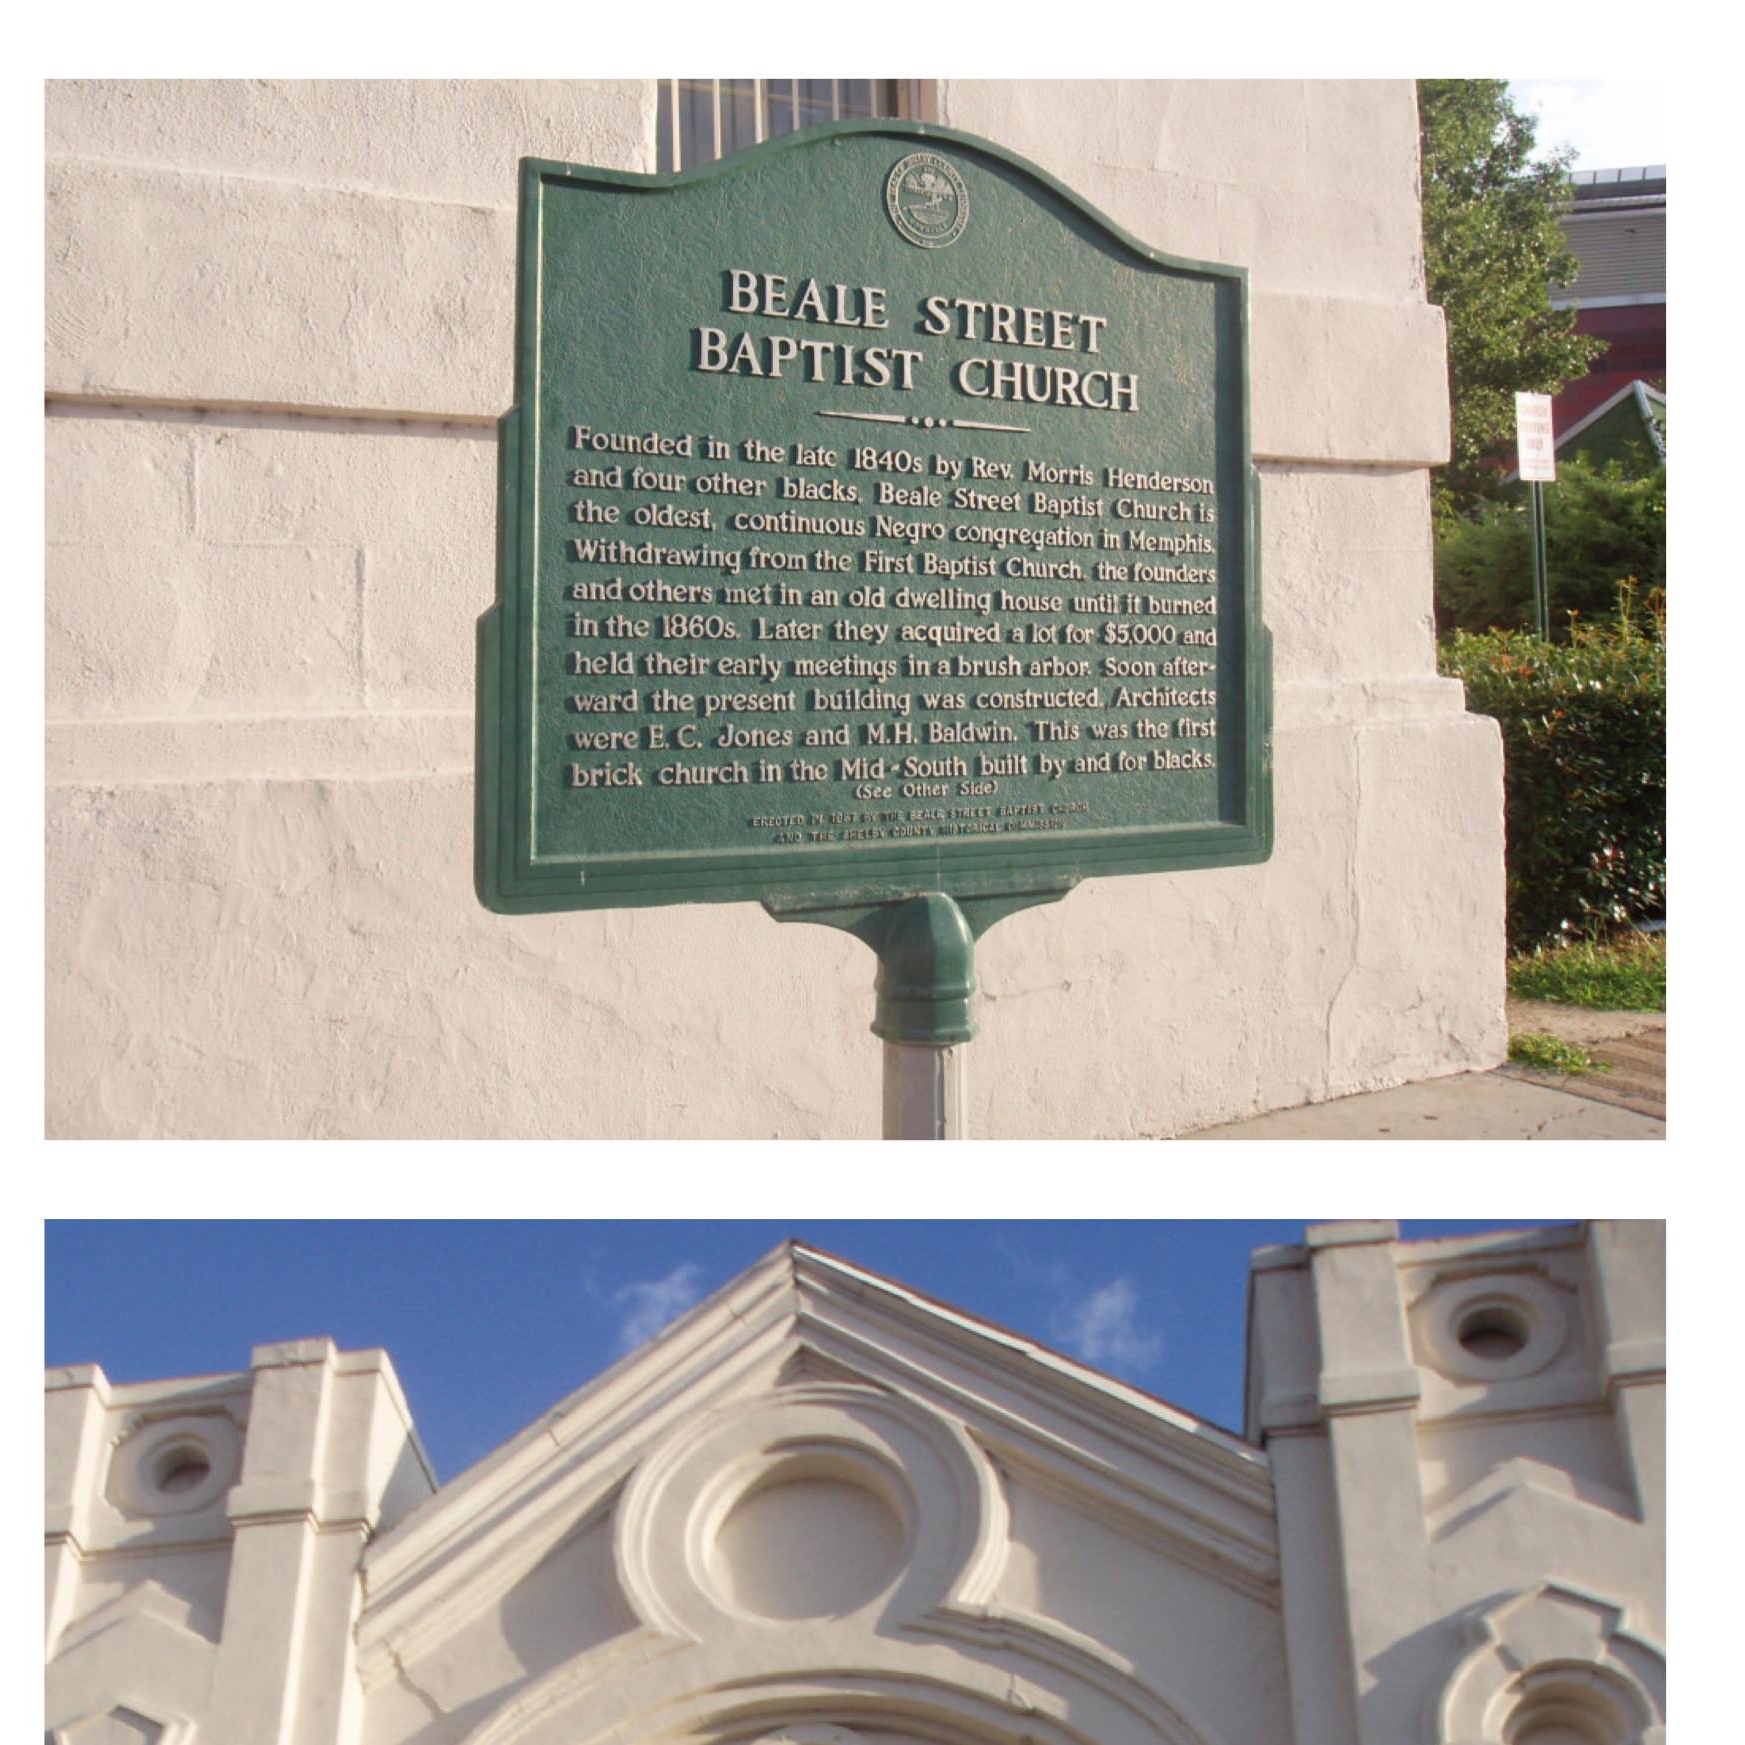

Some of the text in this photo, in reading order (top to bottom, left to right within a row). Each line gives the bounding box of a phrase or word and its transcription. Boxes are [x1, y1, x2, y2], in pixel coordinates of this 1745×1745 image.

[729, 269, 1107, 353] BEALE STREET
[697, 327, 1139, 411] BAPTIST CHURCH
[575, 425, 1214, 494] Founded in the late 1840s by Rev. Morris Henderson
[574, 466, 622, 488] and
[631, 466, 686, 491] four
[696, 472, 766, 496] other
[880, 482, 942, 507] Beale
[954, 488, 1022, 511] Street
[1033, 492, 1103, 519] Baptist
[1116, 499, 1191, 521] Church
[1199, 503, 1214, 522] is
[575, 500, 620, 523] the
[735, 509, 865, 536] continuous
[875, 514, 946, 544] Negro
[955, 524, 1093, 550] congregation
[1103, 529, 1120, 548] in
[575, 538, 741, 574] Withdrawing
[749, 546, 806, 570] from
[815, 549, 852, 571] the
[865, 550, 913, 575] First
[923, 553, 996, 578] Baptist
[1098, 561, 1128, 581] the
[1134, 561, 1215, 583] founders
[573, 577, 1216, 615] and others met in an old dwelling house until it burned
[575, 612, 598, 637] in
[606, 615, 649, 638] the
[662, 614, 740, 639] 1860s.
[758, 617, 822, 640] Later
[834, 619, 889, 644] they
[901, 623, 1000, 646] acquired
[1012, 628, 1024, 642] a
[1032, 624, 1057, 642] lot
[1066, 623, 1095, 644] for
[1182, 629, 1216, 646] and
[575, 652, 1215, 682] held their early meetings in a brush arbor. Soon after-
[575, 689, 638, 712] ward
[652, 688, 695, 711] the
[705, 690, 796, 716] present
[814, 689, 910, 715] building
[923, 692, 965, 709] was
[1116, 687, 1216, 707] Architects
[575, 730, 638, 749] were
[649, 724, 669, 749] E.
[677, 724, 702, 749] C.
[718, 723, 792, 747] Jones
[806, 723, 849, 746] and
[929, 721, 1017, 743] Baldwin.
[1035, 720, 1079, 741] This
[1091, 721, 1128, 739] was
[1136, 719, 1168, 739] the
[1177, 718, 1215, 738] first
[571, 761, 642, 787] brick
[658, 761, 748, 785] church
[759, 761, 781, 782] in
[790, 759, 828, 781] the
[980, 751, 1027, 775] built
[1039, 752, 1066, 778] by
[1075, 750, 1110, 773] and
[1118, 751, 1147, 772] for
[1154, 749, 1215, 770] blacks.
[857, 780, 998, 799] (See Other Side)
[753, 815, 804, 827] ERECTED
[911, 808, 944, 820] BEALE
[950, 807, 991, 818] STREET
[1000, 804, 1044, 816] BAPTIST
[812, 831, 834, 841] THE
